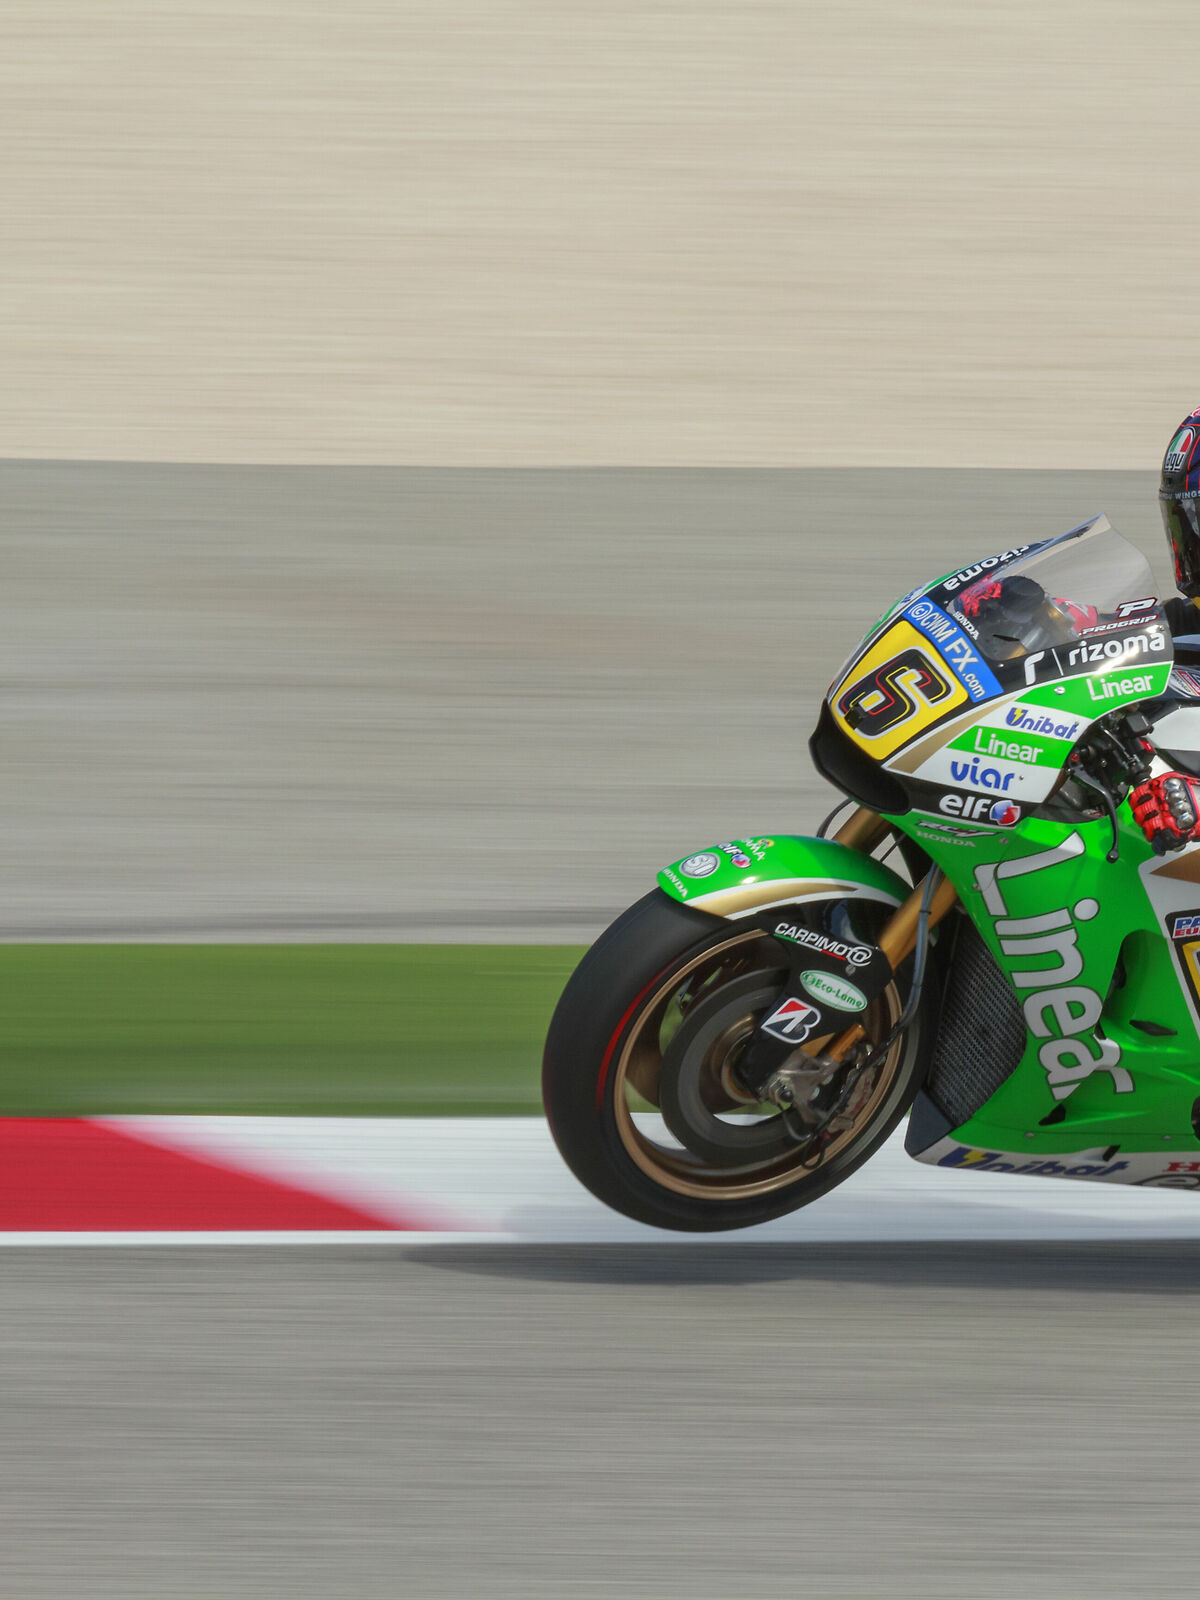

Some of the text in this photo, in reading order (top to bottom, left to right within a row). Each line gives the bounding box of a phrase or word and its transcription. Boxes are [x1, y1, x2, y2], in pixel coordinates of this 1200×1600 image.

[1164, 453, 1185, 471] agv
[952, 611, 980, 640] HONDA
[1081, 614, 1157, 635] PROGRIP
[1069, 632, 1165, 666] rizoma
[836, 645, 957, 741] 6
[1087, 674, 1154, 701] Linear
[1004, 707, 1078, 740] Unibat
[974, 728, 1043, 763] Linear
[950, 757, 1016, 791] viar
[938, 794, 991, 820] elf
[916, 830, 977, 848] HONDA
[973, 831, 1135, 1101] Linear
[937, 1147, 1130, 1176] Unibat
